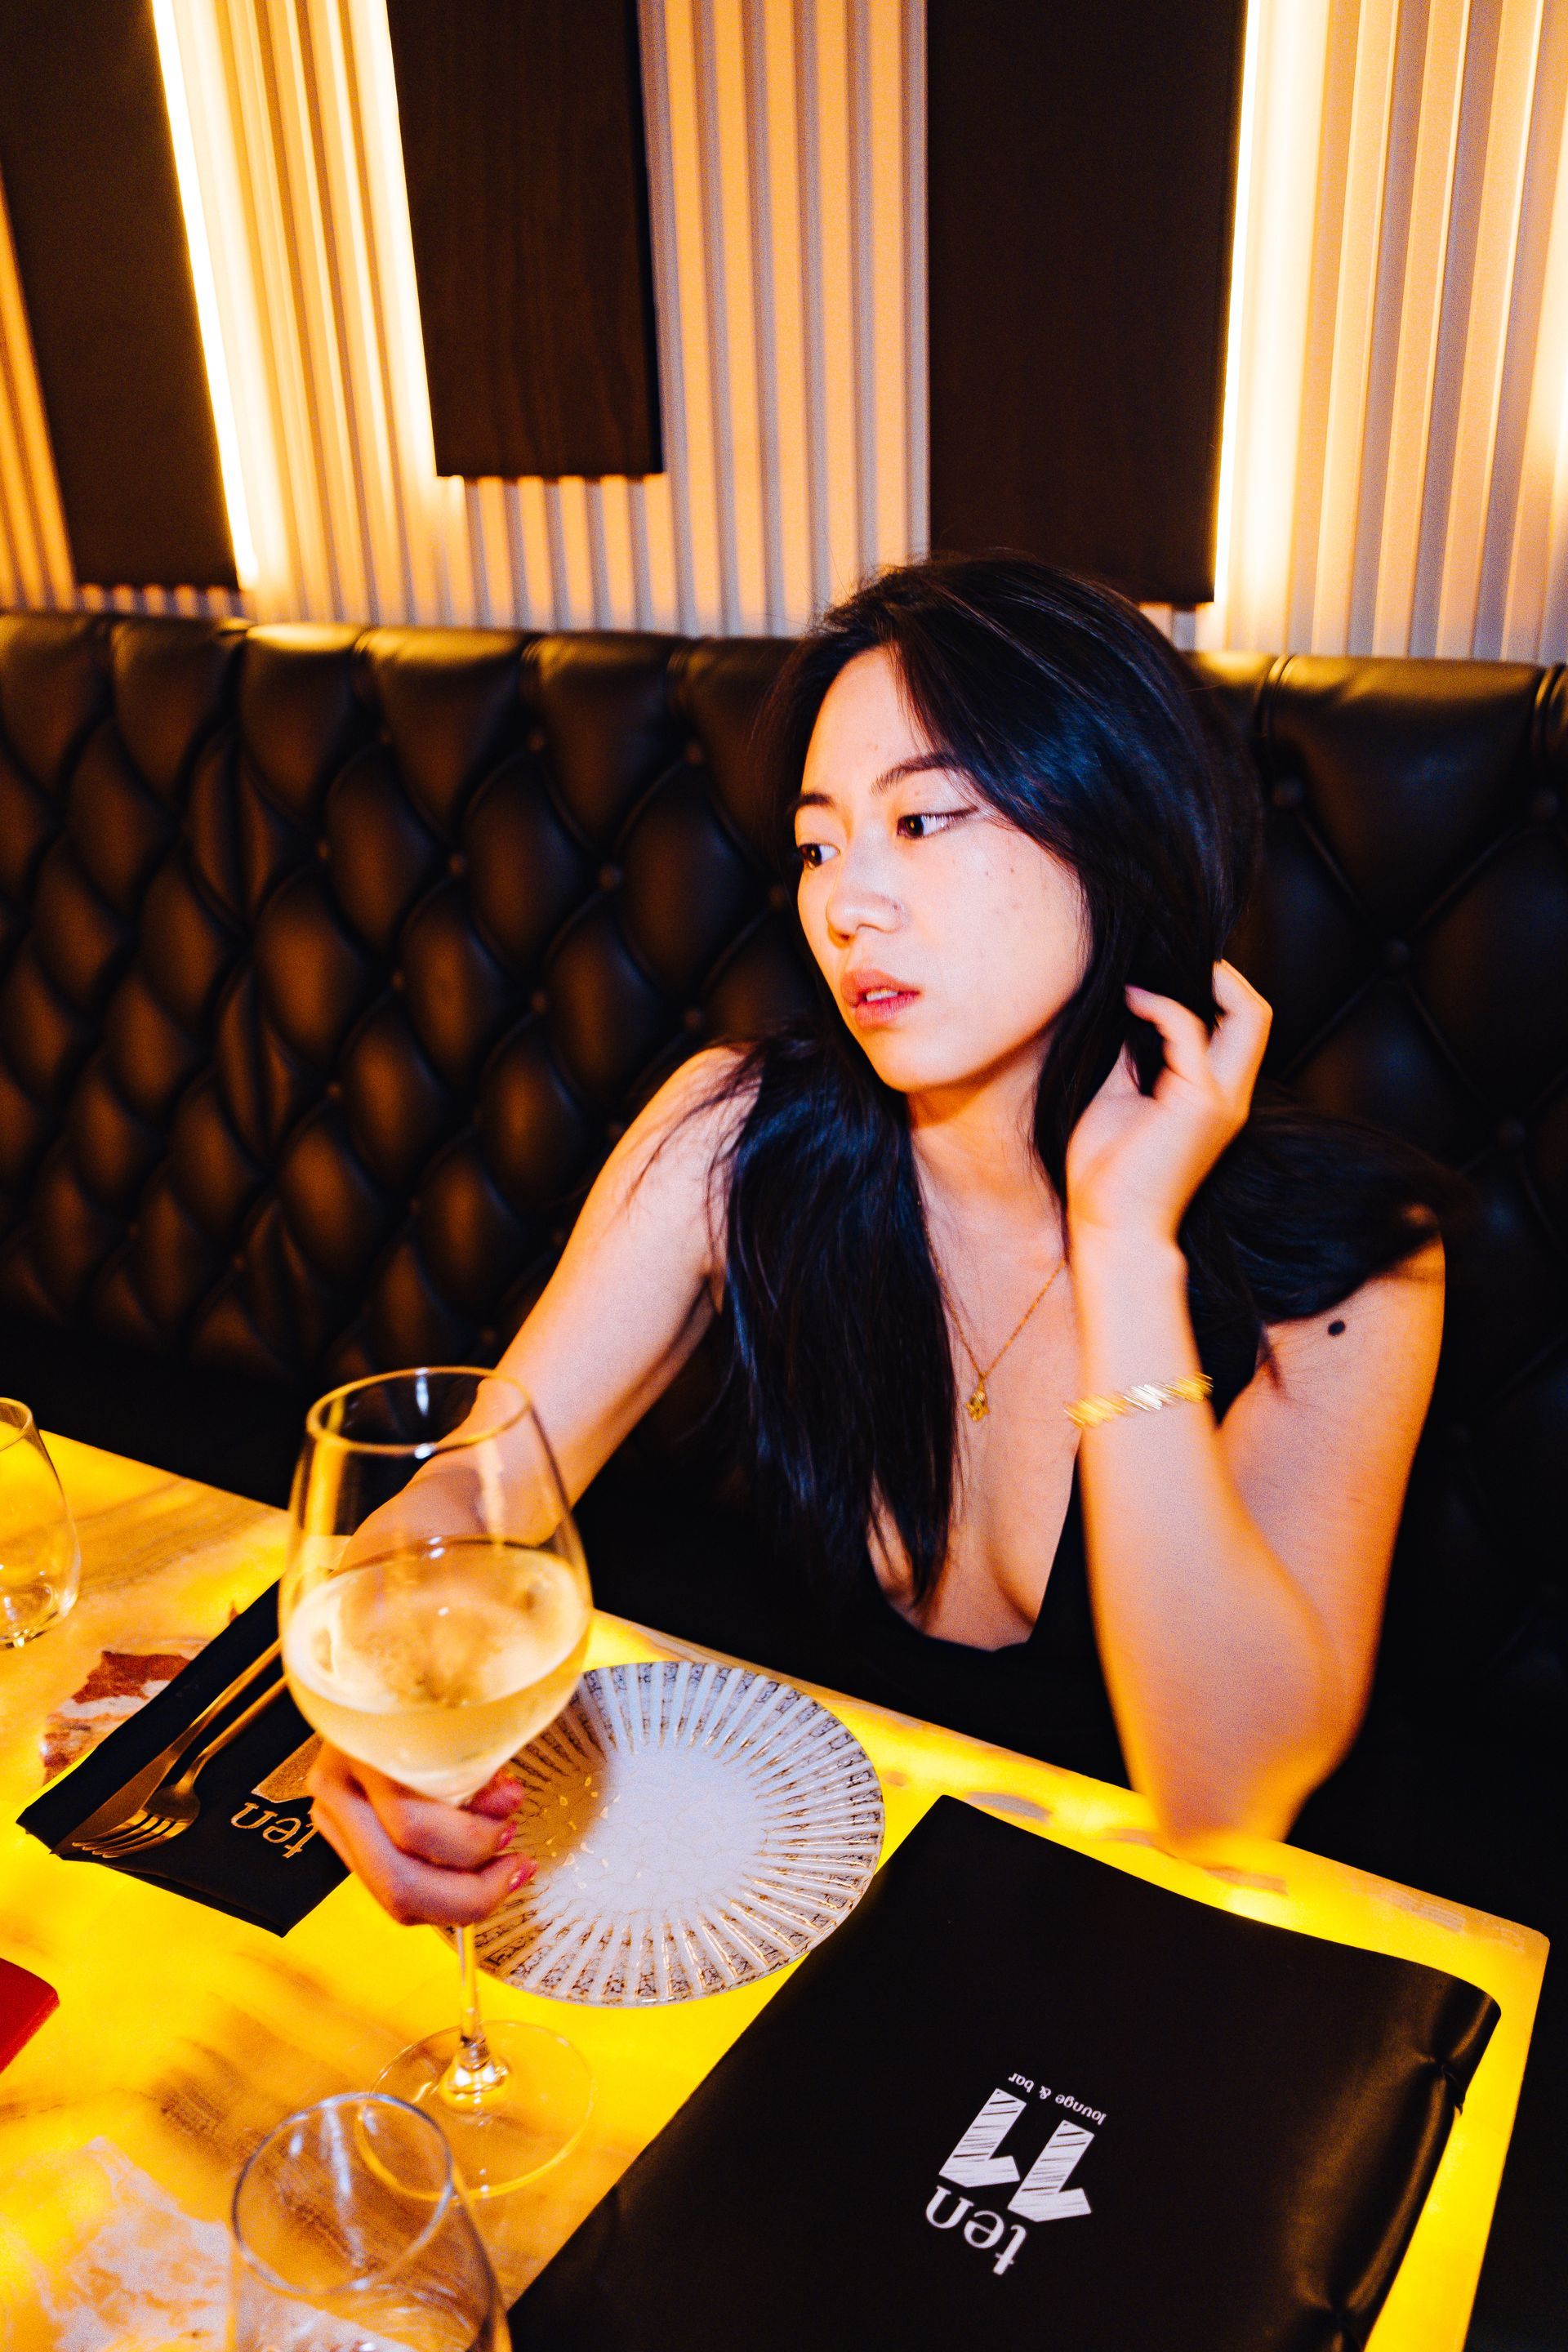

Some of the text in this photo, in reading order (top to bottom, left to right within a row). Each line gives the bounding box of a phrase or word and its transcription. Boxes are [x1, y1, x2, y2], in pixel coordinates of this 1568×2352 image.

[230, 1802, 319, 1859] ten
[1008, 2072, 1107, 2126] lounge & bar
[924, 2185, 1027, 2275] ten
